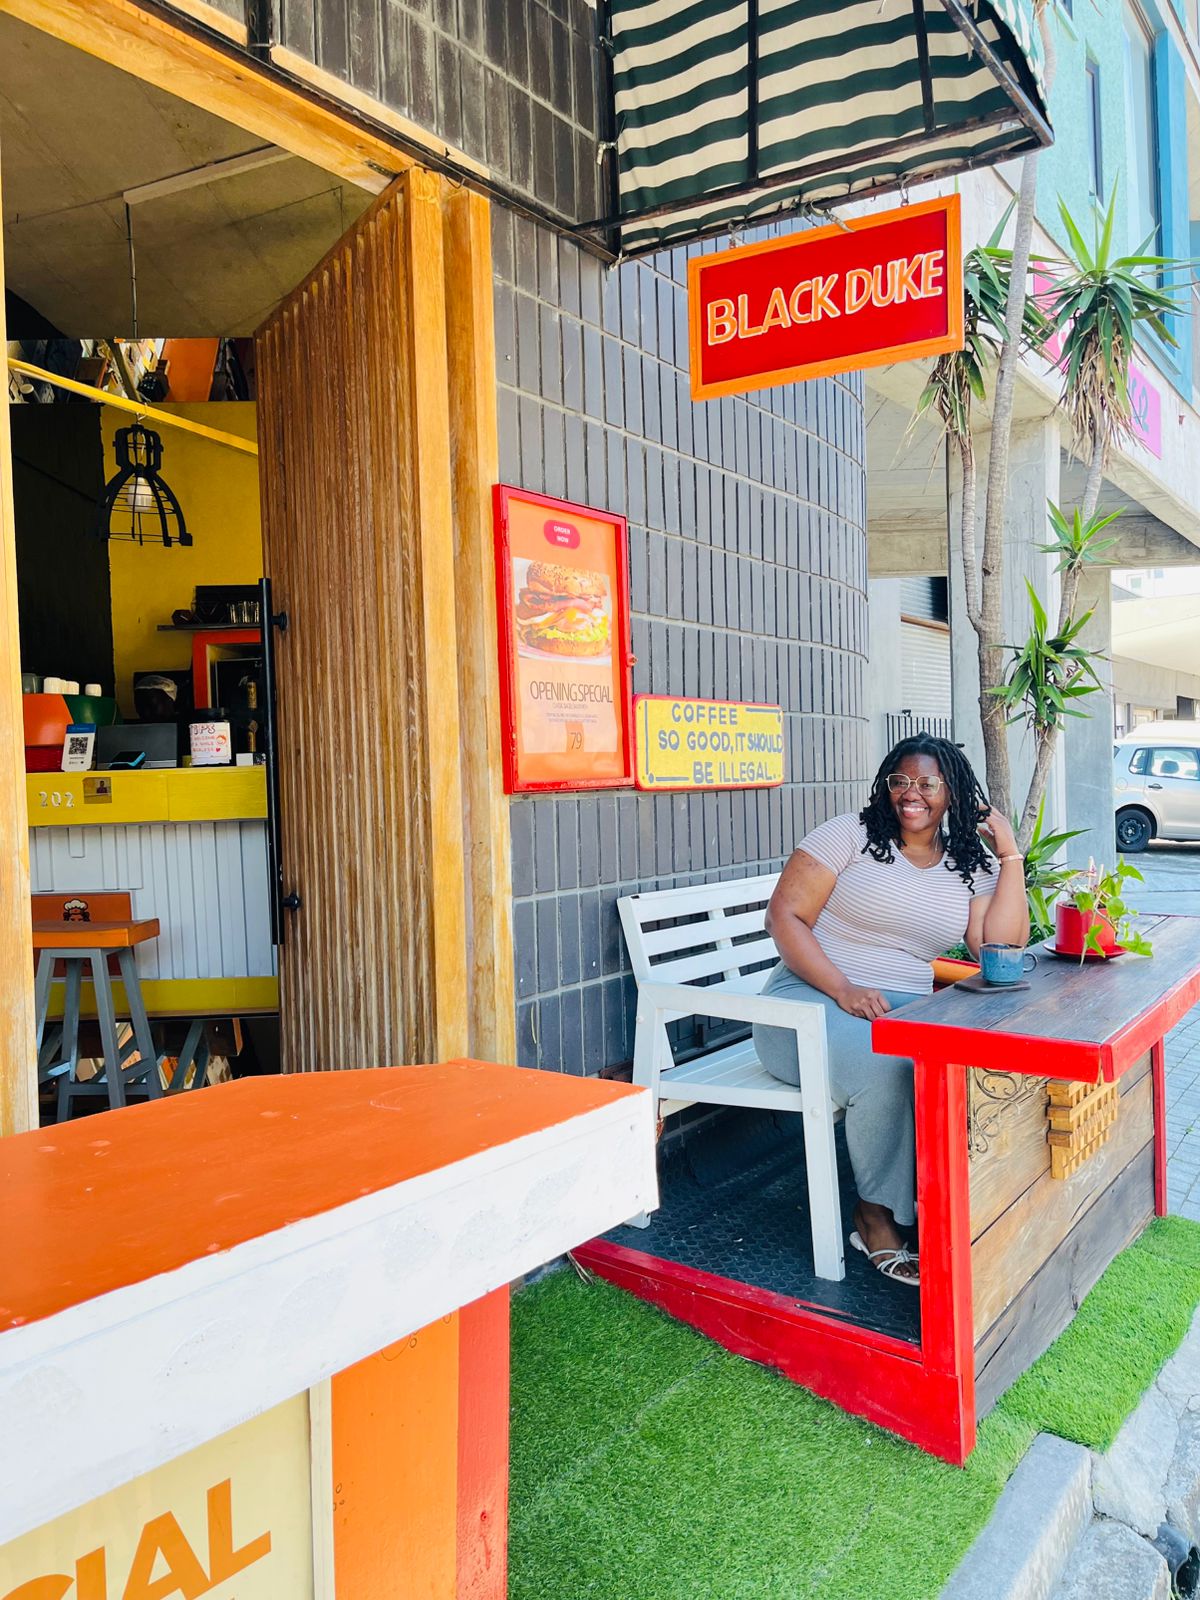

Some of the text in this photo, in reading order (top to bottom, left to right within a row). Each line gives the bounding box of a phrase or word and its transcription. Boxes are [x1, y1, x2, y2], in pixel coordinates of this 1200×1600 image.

[707, 249, 944, 346] BLACK DUKE
[530, 680, 613, 704] OPENING SPECIAL
[671, 703, 738, 725] COFFEE
[570, 731, 583, 750] 79
[658, 729, 680, 751] SO
[693, 761, 777, 784] BE ILLEGAL.
[39, 791, 75, 808] 202
